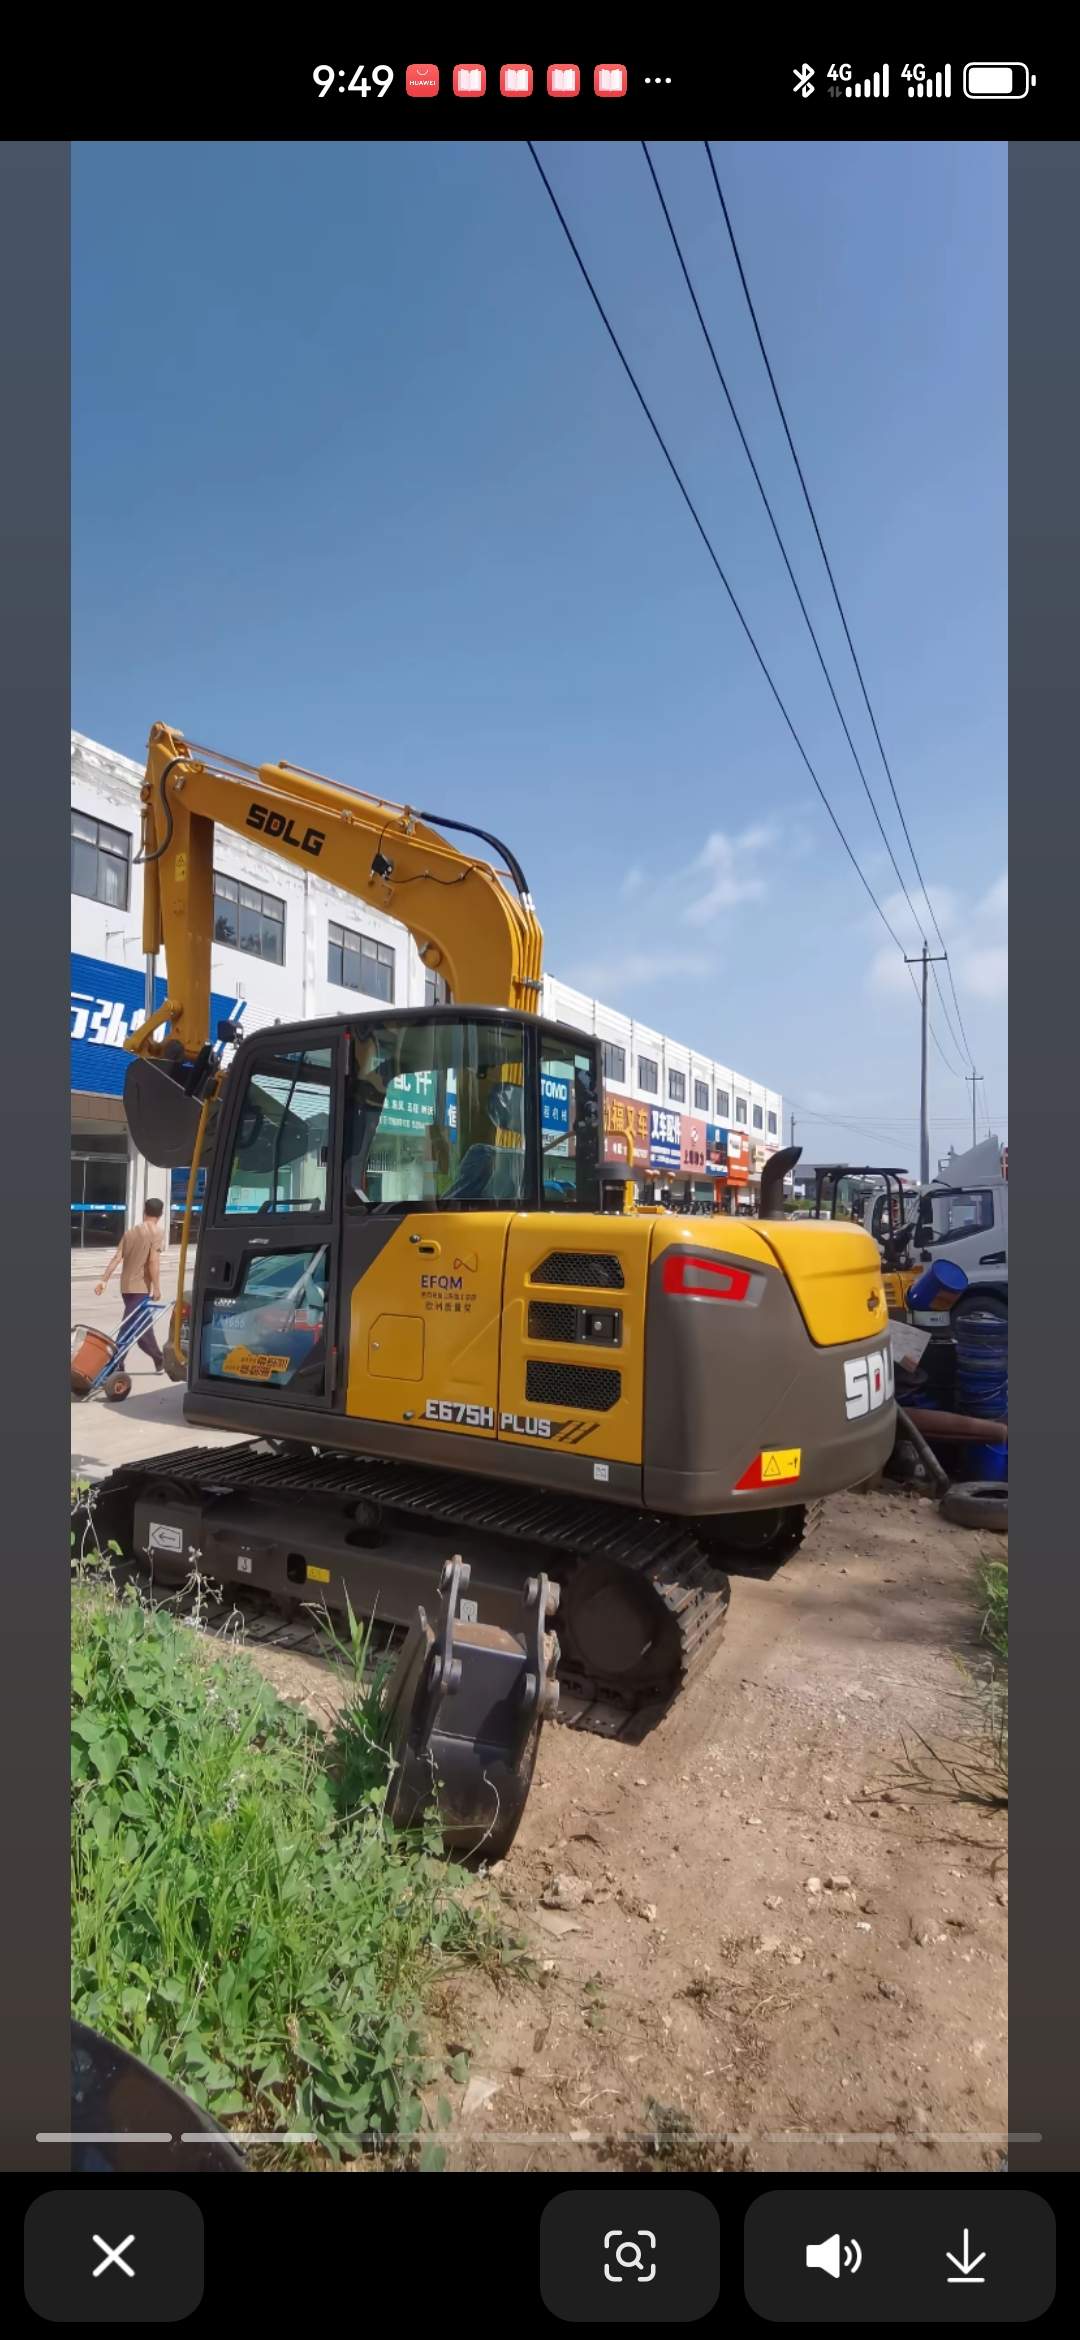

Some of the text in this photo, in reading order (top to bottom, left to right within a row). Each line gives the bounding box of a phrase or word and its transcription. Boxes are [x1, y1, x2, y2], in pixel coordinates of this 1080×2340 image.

[246, 803, 326, 856] SDLG
[604, 1098, 648, 1140] 福叉车
[421, 1275, 463, 1290] EFQM
[844, 1347, 894, 1420] SDL
[426, 1399, 551, 1437] E675H PLUS
